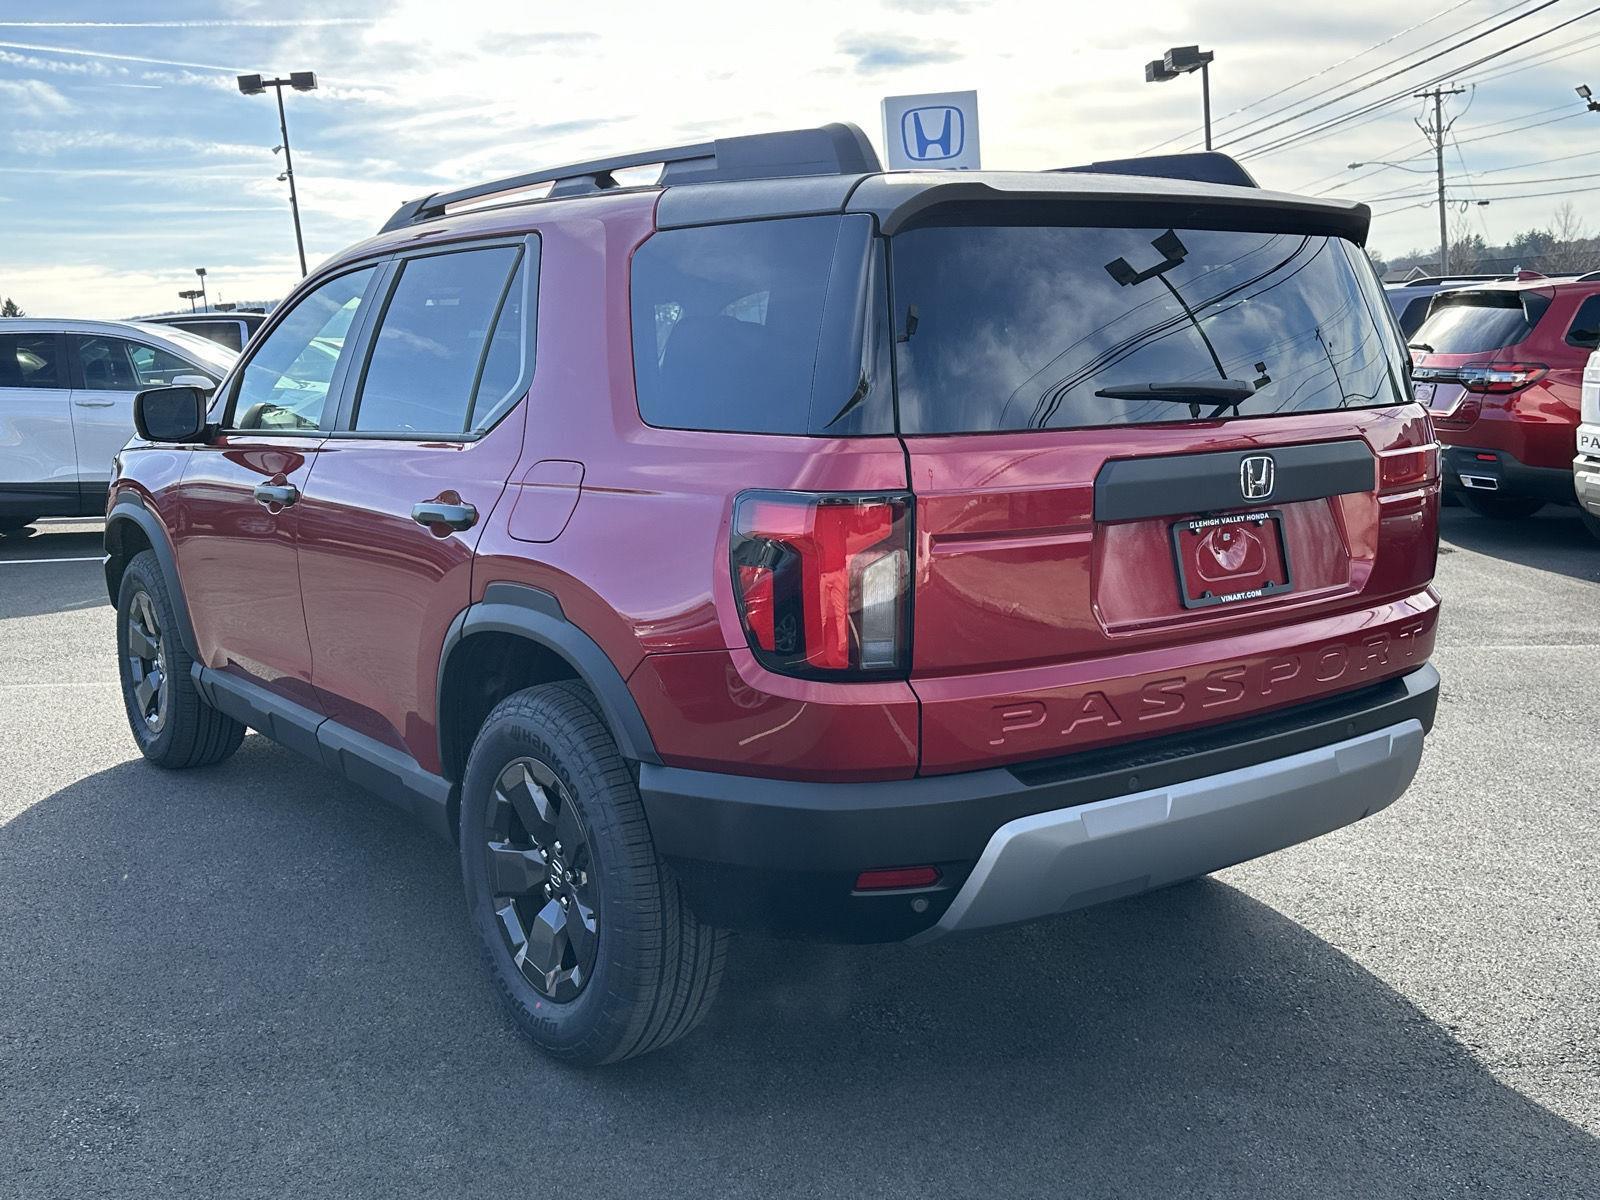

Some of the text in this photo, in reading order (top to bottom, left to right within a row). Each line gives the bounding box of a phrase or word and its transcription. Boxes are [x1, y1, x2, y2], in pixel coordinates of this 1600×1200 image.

[1195, 512, 1269, 527] LEHIGH VALLEY HONDA
[1221, 589, 1262, 602] VINART.COM
[989, 622, 1424, 745] PASSPORT
